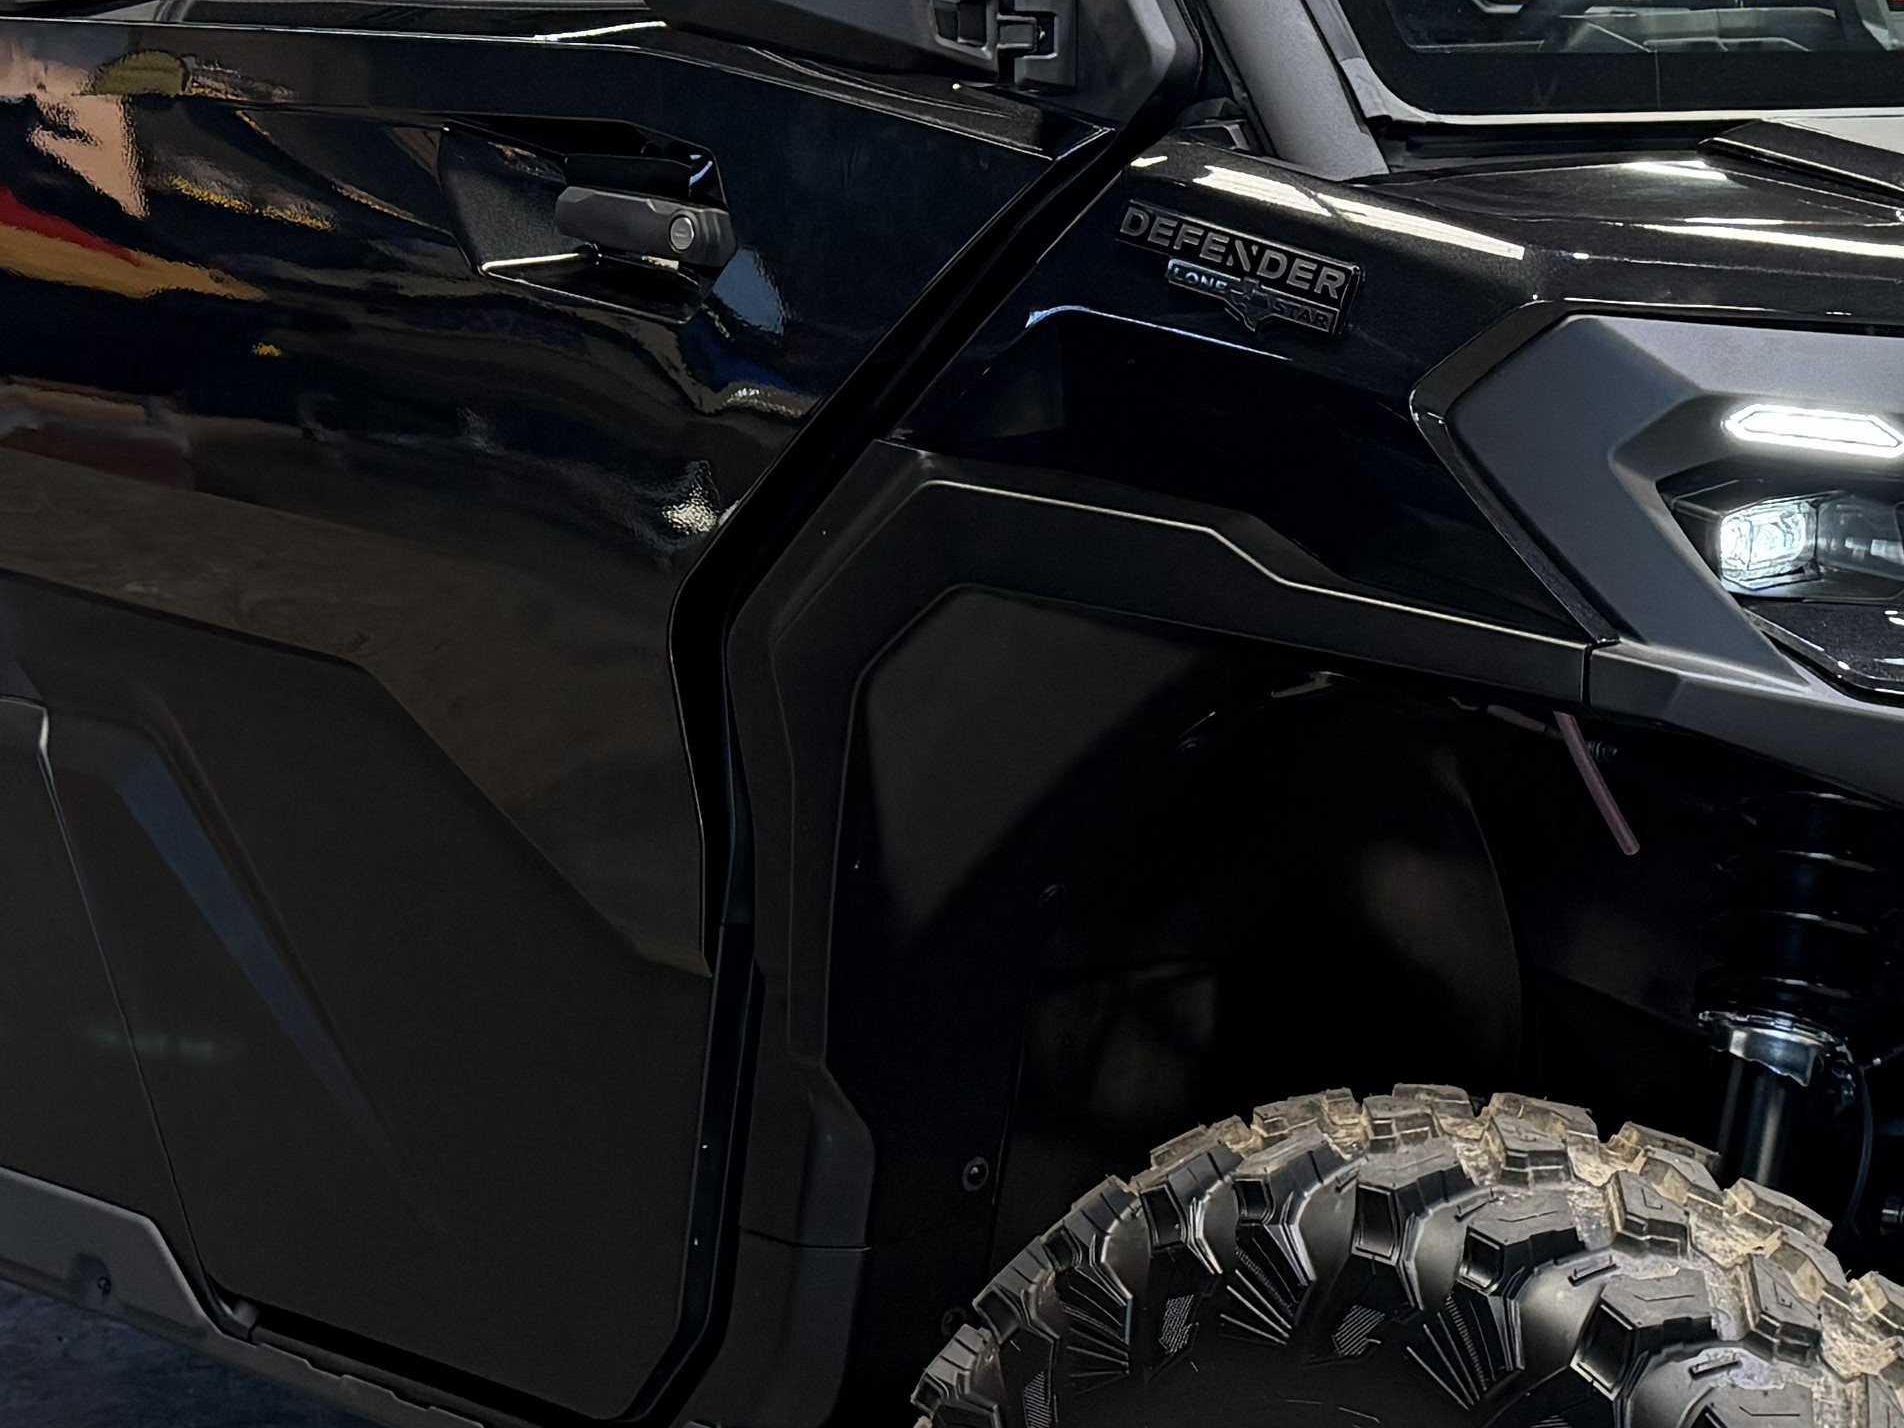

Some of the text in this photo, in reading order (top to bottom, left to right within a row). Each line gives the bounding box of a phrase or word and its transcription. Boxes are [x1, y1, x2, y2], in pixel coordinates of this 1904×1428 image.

[1118, 205, 1347, 300] DEFENDER
[1171, 266, 1332, 330] LONE STAR
